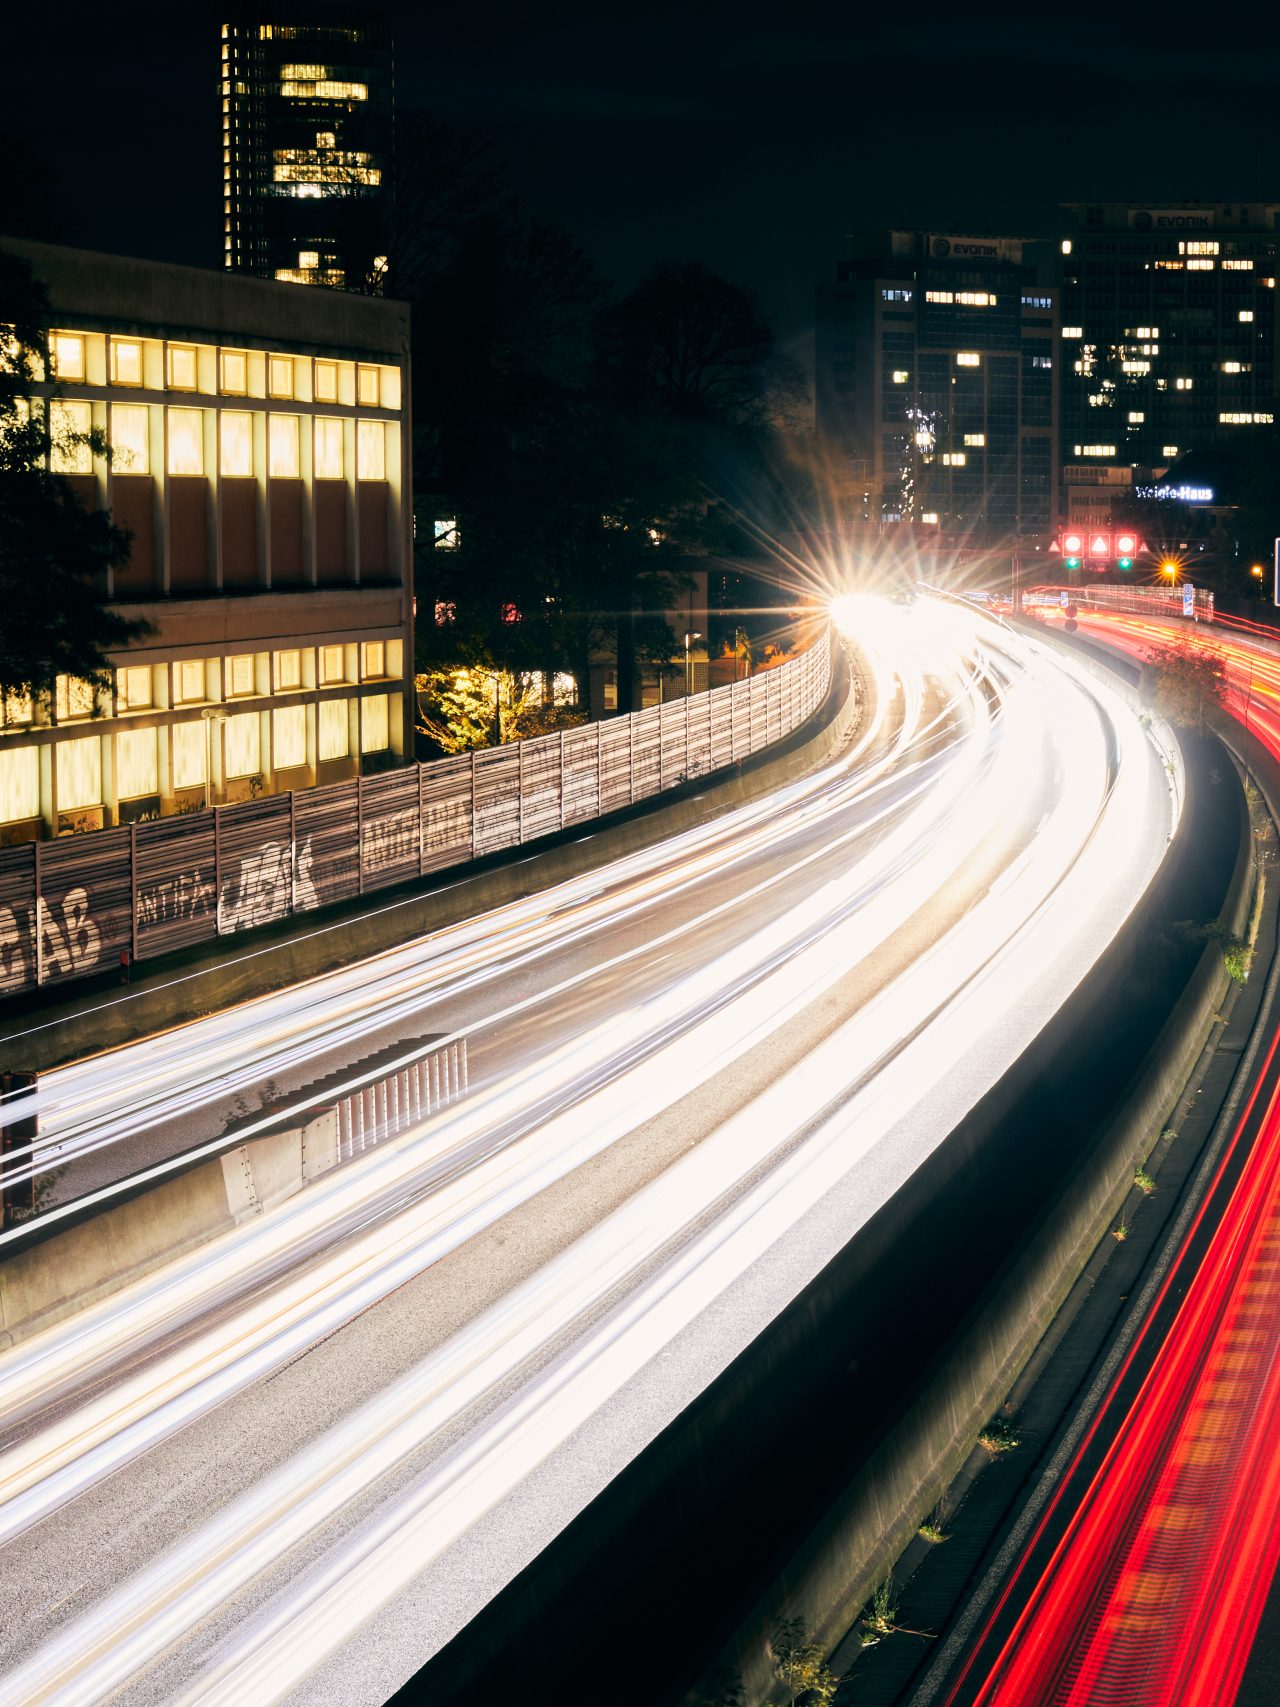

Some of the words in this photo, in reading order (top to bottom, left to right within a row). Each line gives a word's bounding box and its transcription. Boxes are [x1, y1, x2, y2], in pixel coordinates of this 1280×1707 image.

[1157, 216, 1209, 227] EVONIK
[953, 244, 998, 256] EVONIK
[1135, 485, 1213, 501] Weigle-Haus
